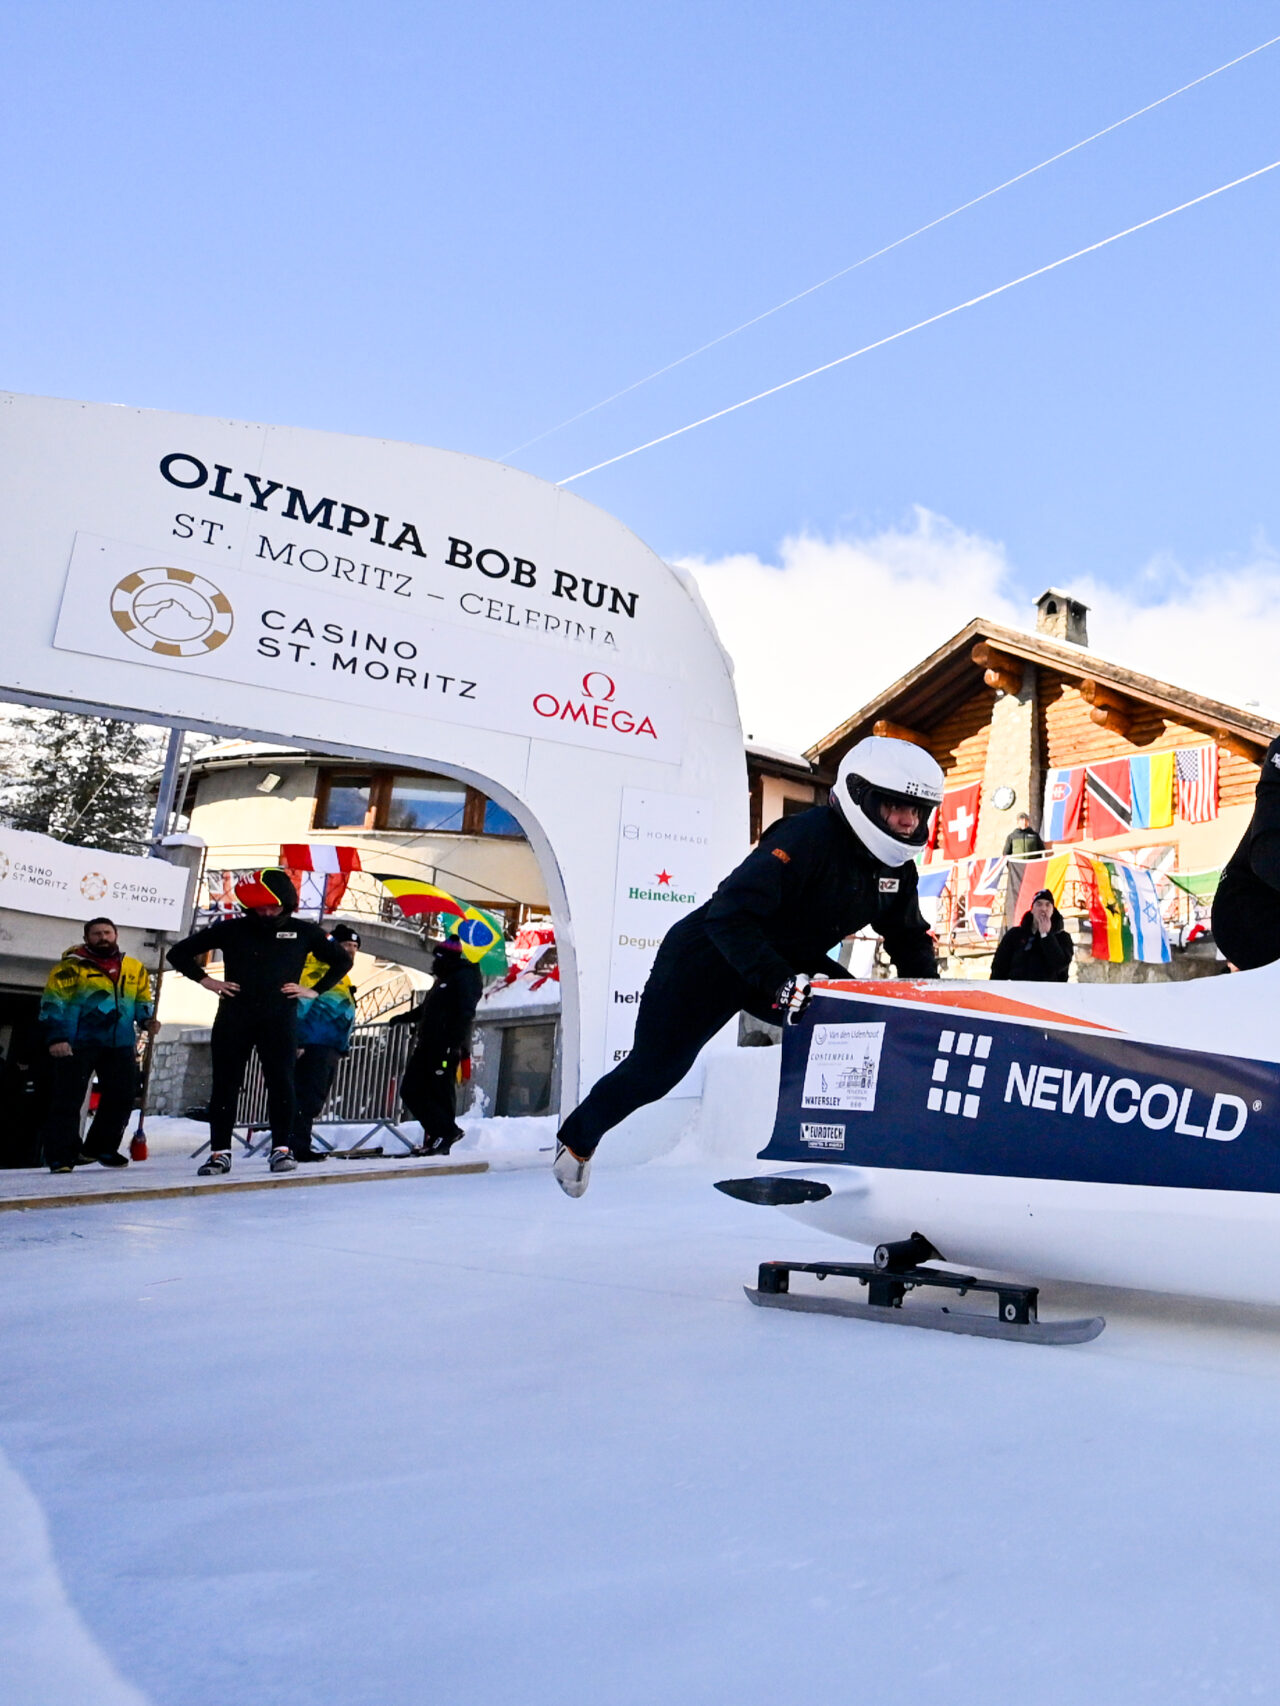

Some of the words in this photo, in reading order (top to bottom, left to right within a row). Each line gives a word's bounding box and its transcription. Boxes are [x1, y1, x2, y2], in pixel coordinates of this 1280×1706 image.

[159, 452, 427, 558] OLYMPIA
[445, 536, 537, 588] BOB
[552, 569, 640, 619] RUN
[172, 513, 232, 550] ST.
[255, 535, 413, 598] MORITZ
[261, 610, 418, 660] CASINO
[256, 636, 317, 667] ST.
[332, 652, 478, 700] MORITZ
[532, 693, 658, 740] OMEGA
[646, 832, 708, 845] HOMEMADE
[14, 862, 53, 877] CASINO
[12, 873, 26, 883] ST.
[29, 876, 69, 890] MORITZ
[113, 881, 158, 895] CASINO
[112, 891, 128, 900] ST.
[131, 894, 175, 906] MORITZ
[628, 887, 696, 904] Heineken
[805, 1095, 841, 1107] WATERSLEY
[810, 1125, 843, 1140] EUROTECH
